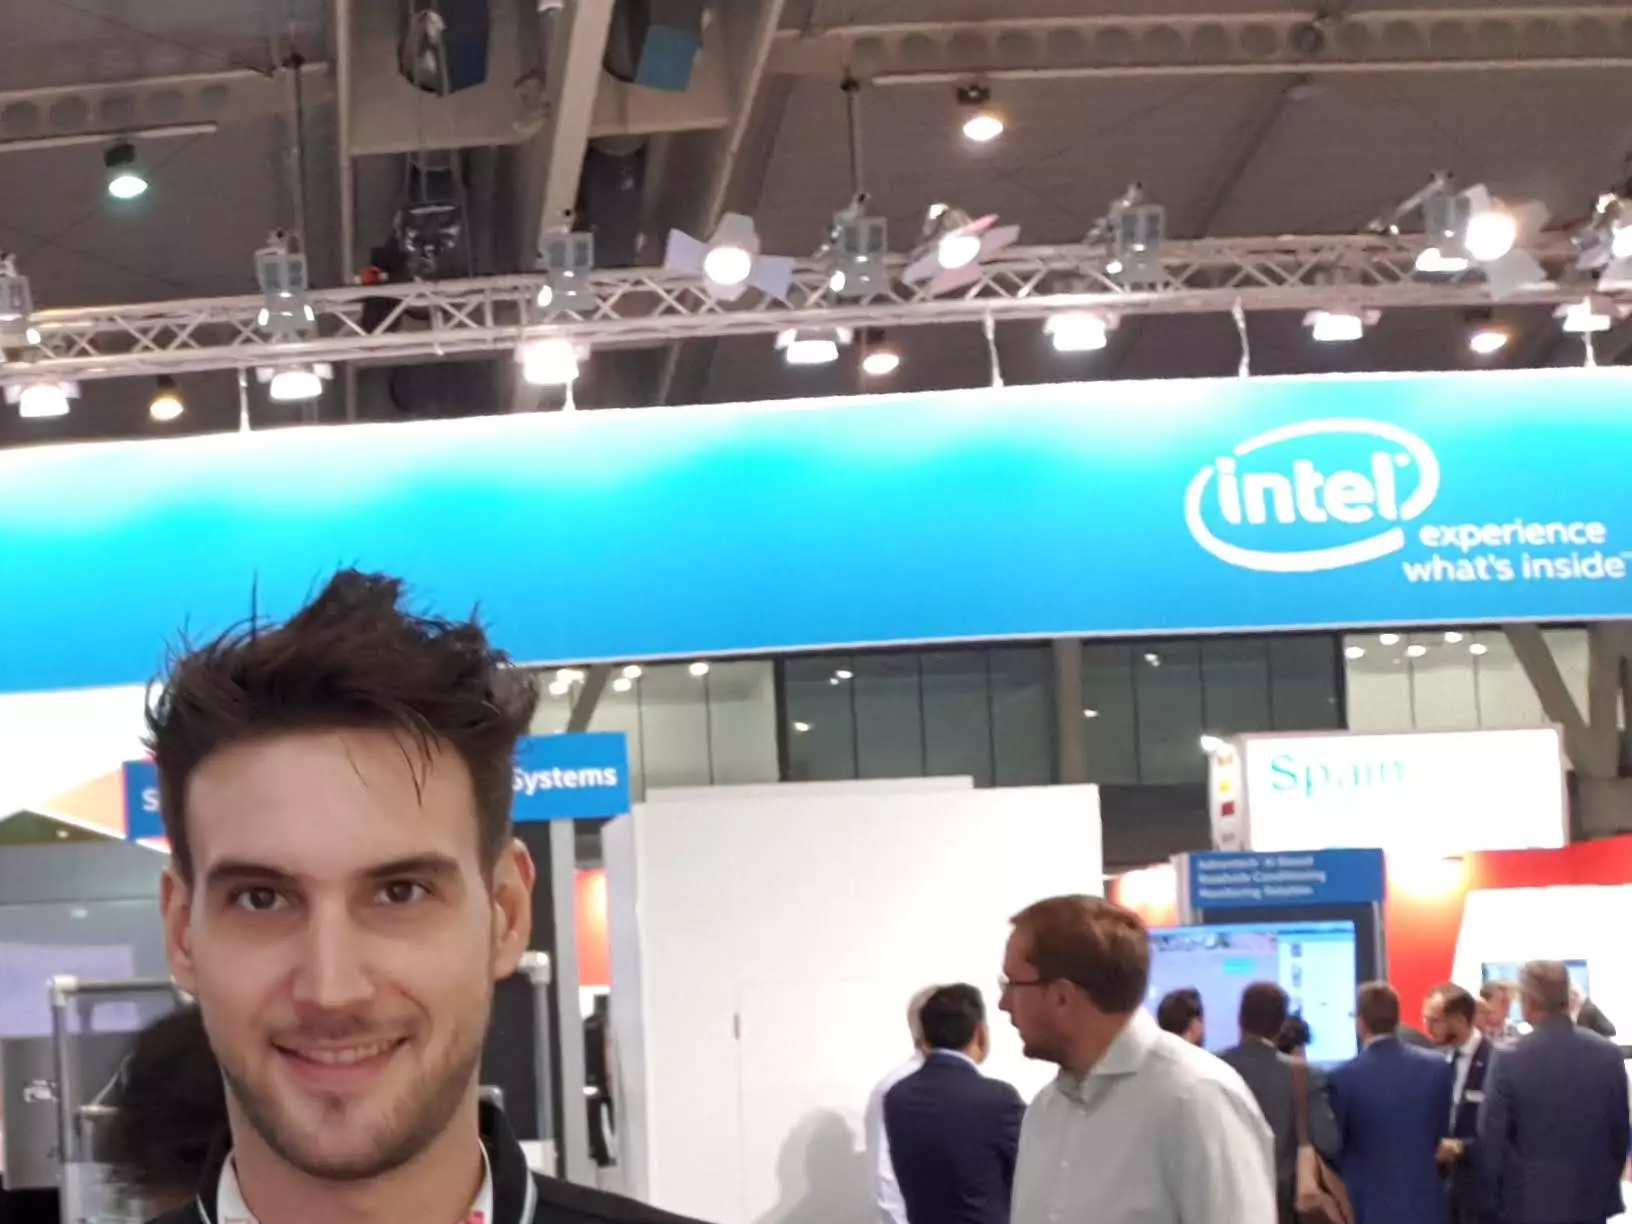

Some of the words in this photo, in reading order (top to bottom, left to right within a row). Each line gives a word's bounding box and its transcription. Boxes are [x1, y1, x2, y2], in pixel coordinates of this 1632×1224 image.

[1215, 451, 1398, 525] intel
[1418, 519, 1607, 552] experience
[1402, 553, 1515, 583] what's
[1521, 551, 1627, 579] inside
